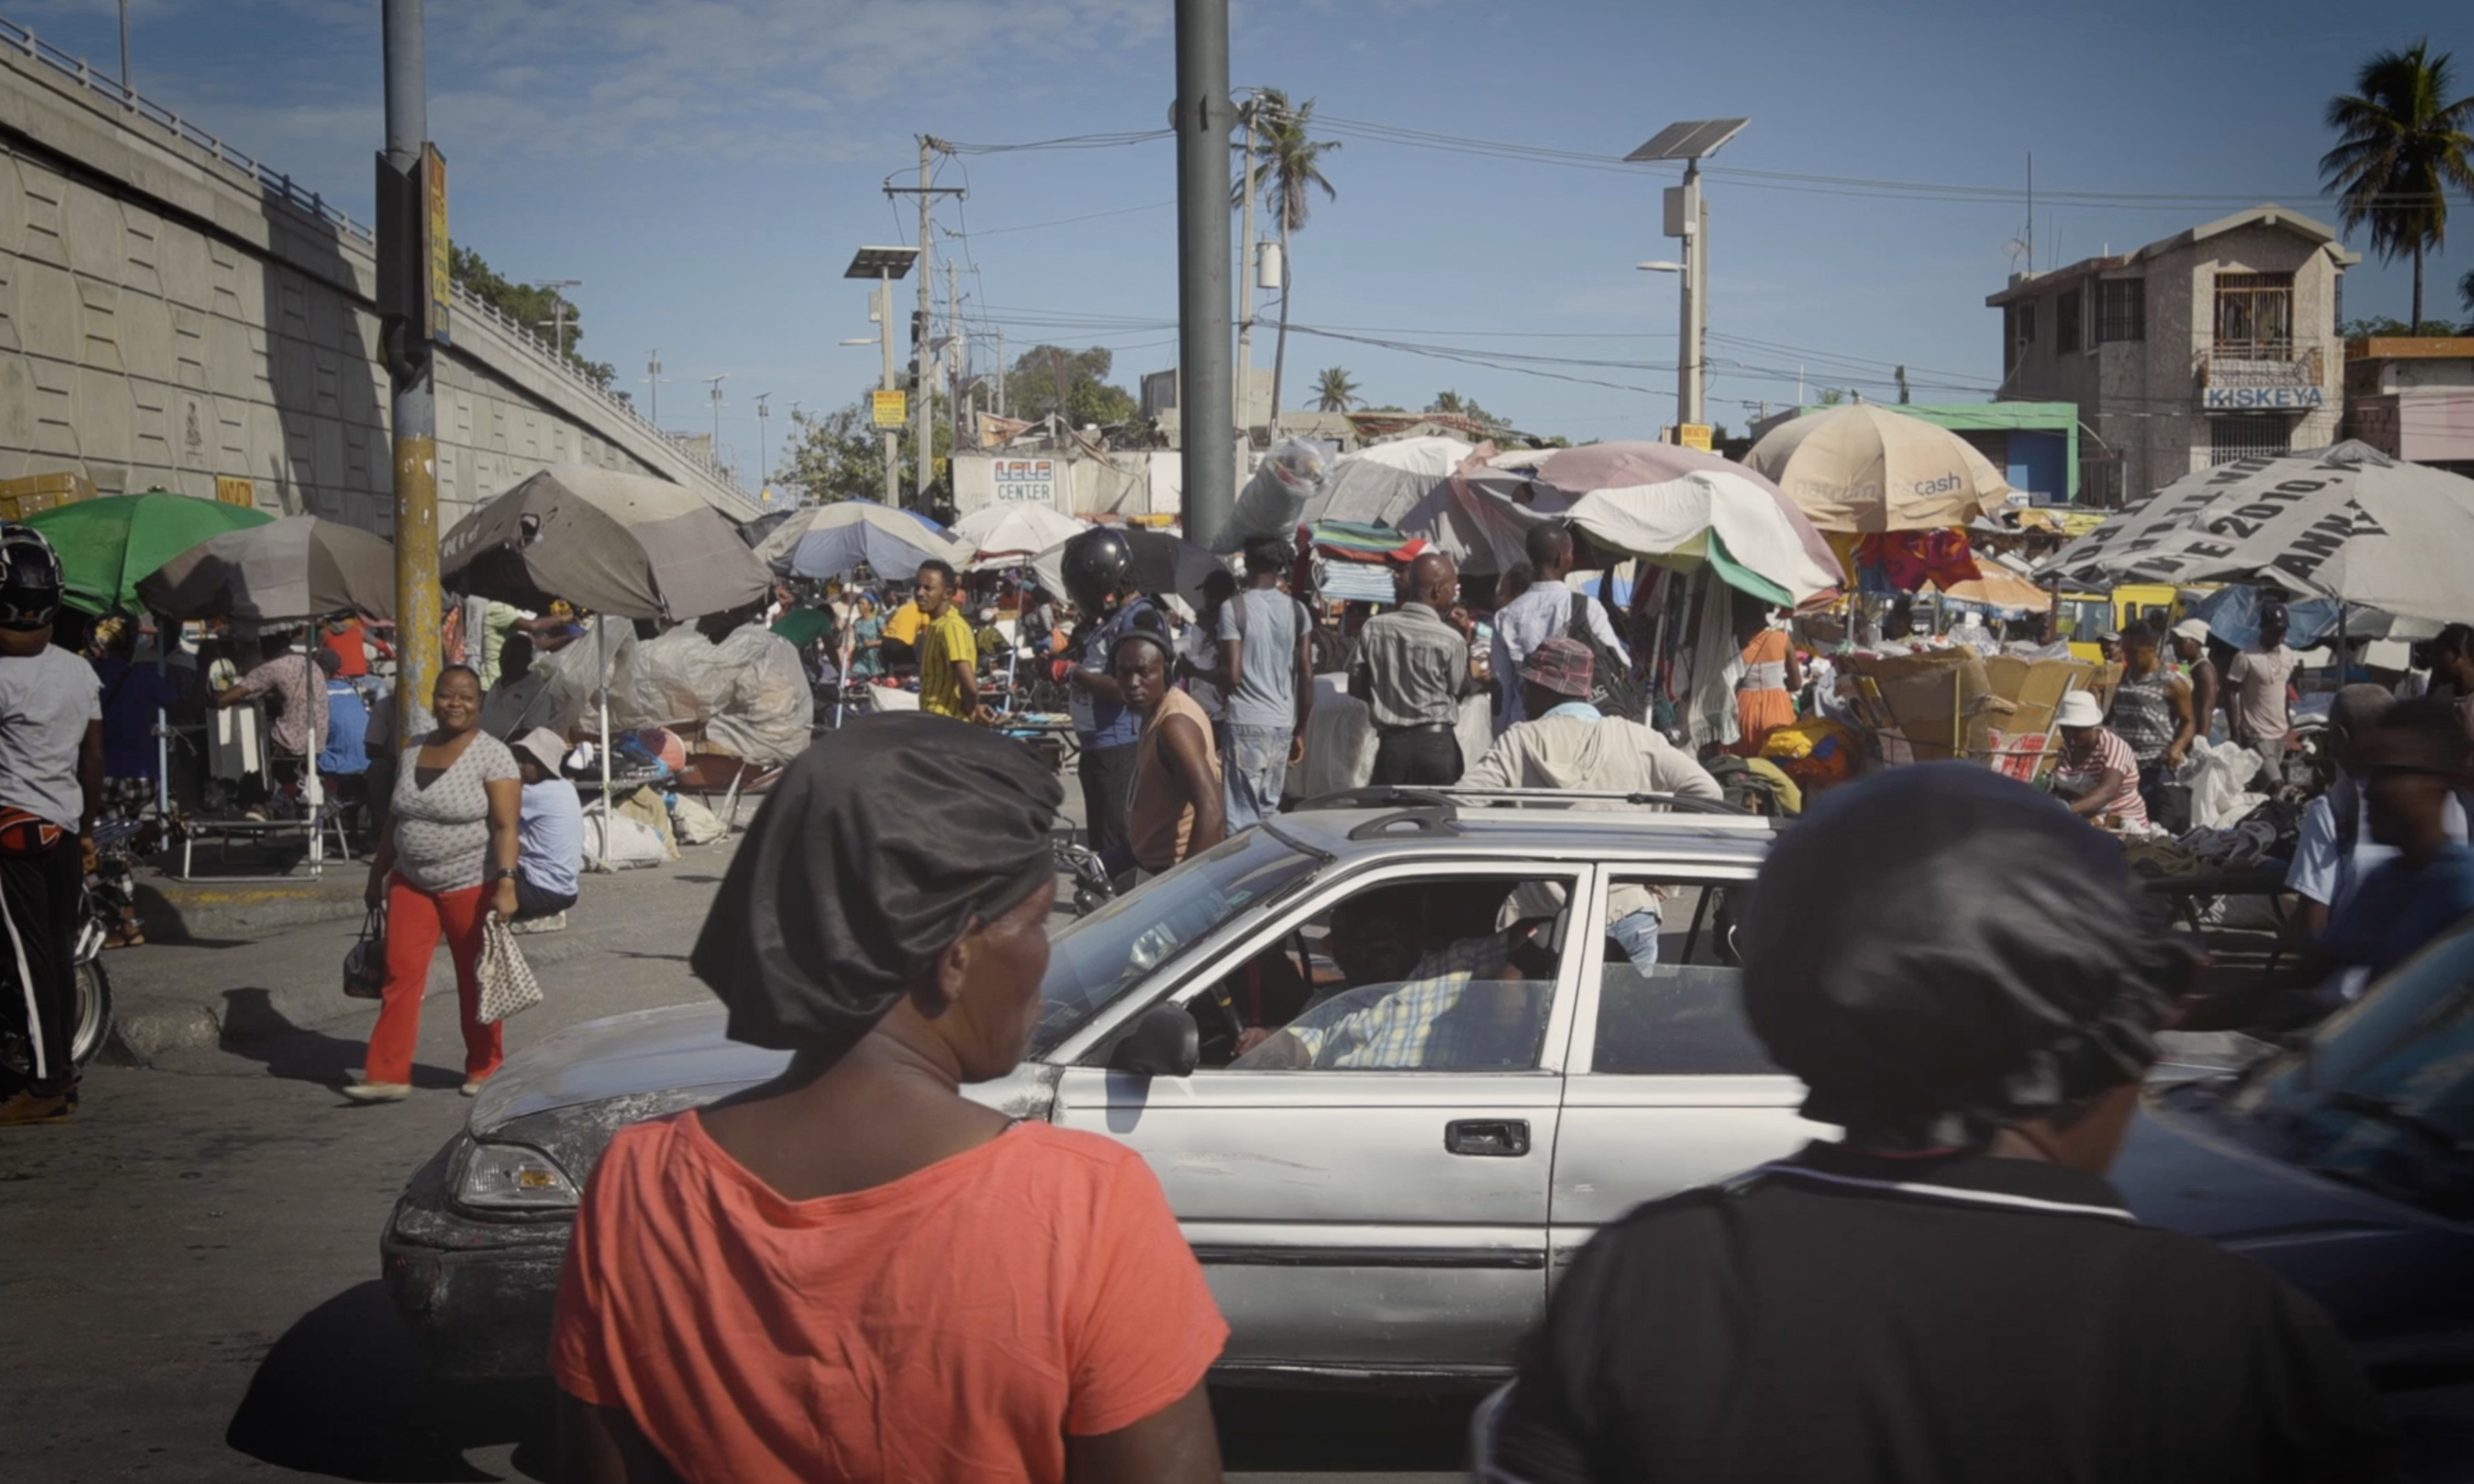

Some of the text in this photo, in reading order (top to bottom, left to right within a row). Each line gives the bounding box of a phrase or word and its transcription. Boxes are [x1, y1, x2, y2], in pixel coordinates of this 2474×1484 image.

[2209, 388, 2324, 407] KISKEYA
[995, 461, 1052, 482] LELE
[998, 484, 1051, 500] CENTER
